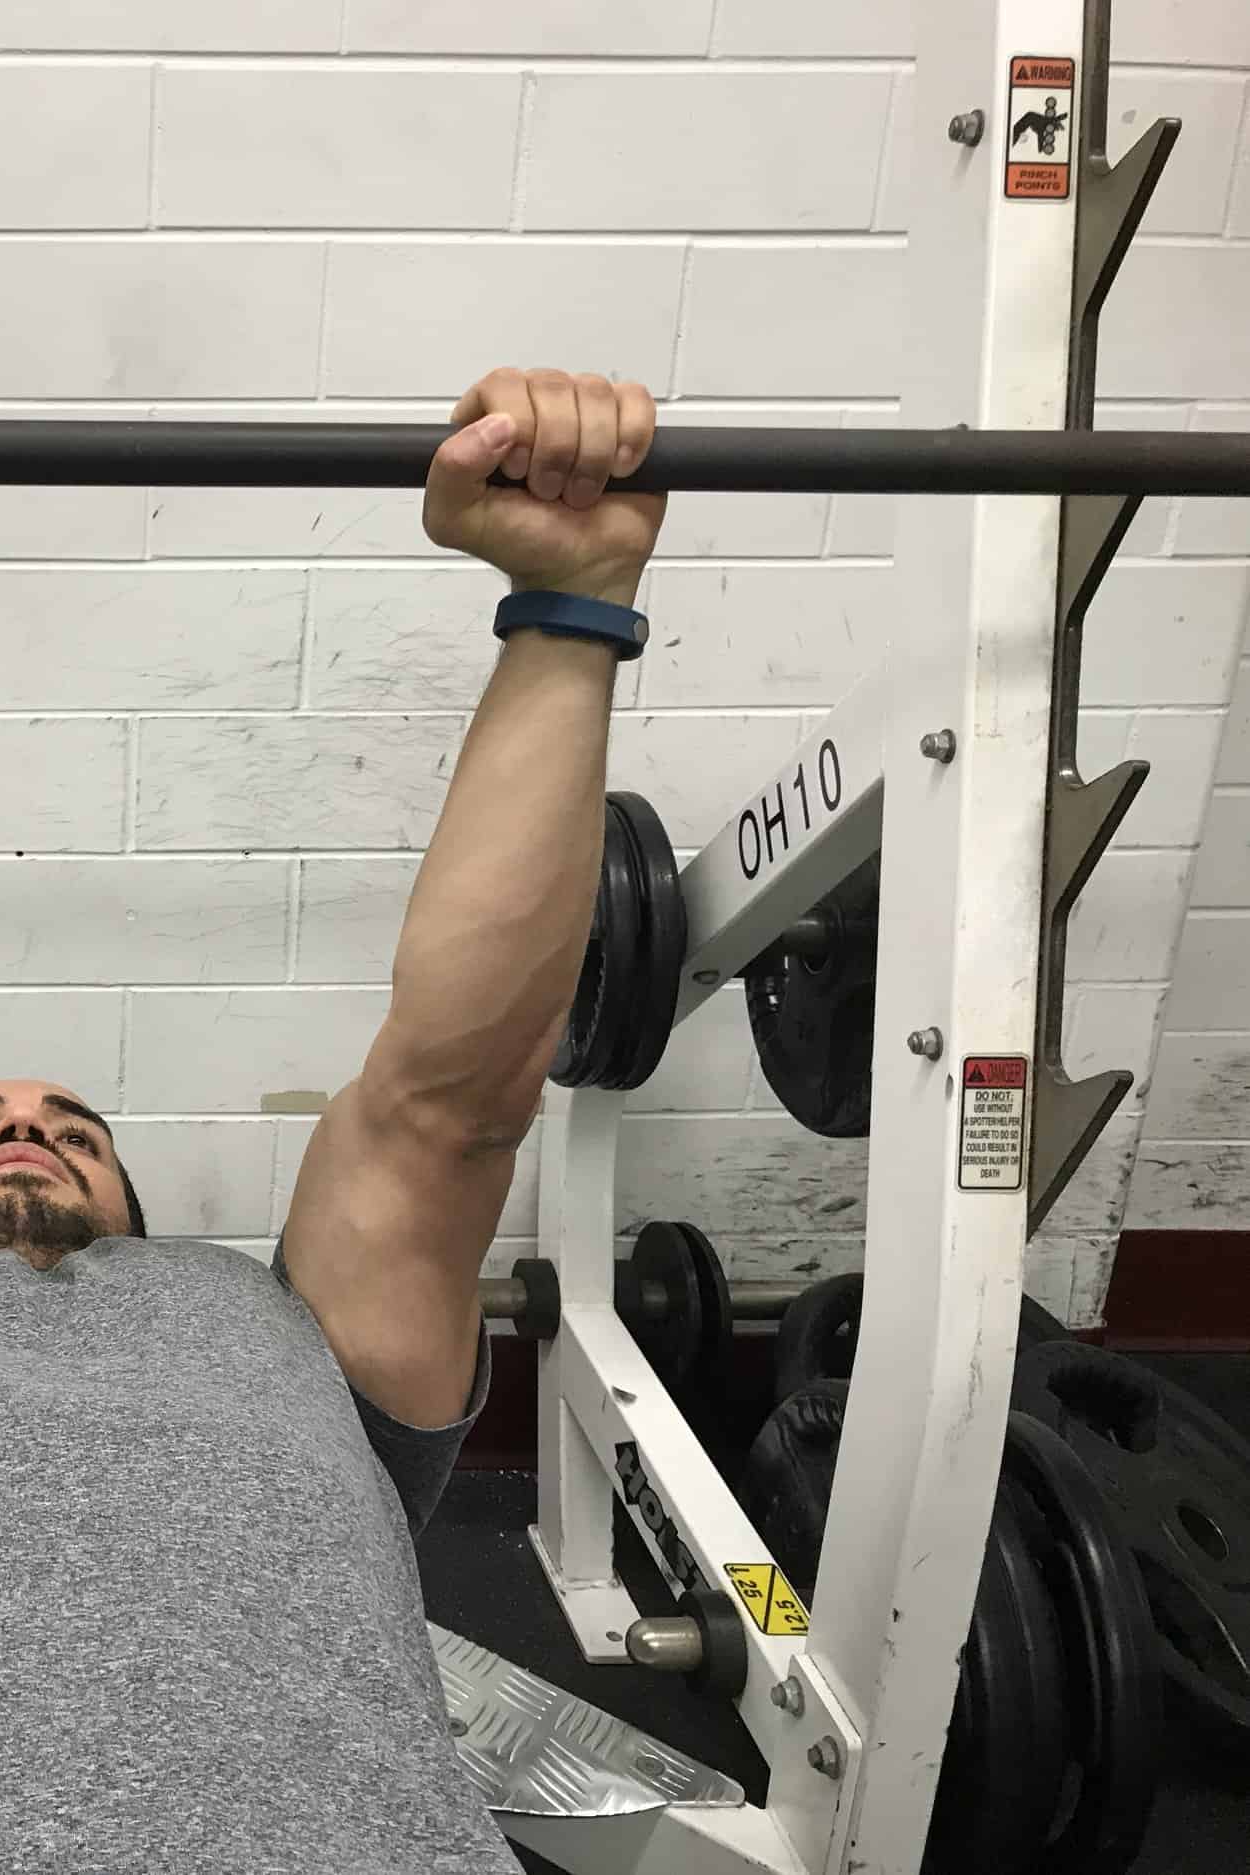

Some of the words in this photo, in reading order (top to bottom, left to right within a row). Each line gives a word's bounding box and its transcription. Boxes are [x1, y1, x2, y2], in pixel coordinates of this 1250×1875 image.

[1030, 65, 1071, 81] WARNING
[1019, 170, 1057, 179] PINCH
[1015, 180, 1061, 190] POINTS
[738, 738, 841, 880] OH10
[988, 1063, 1022, 1083] DANGER
[976, 1091, 989, 1101] DO
[987, 1103, 1013, 1113] WITHOUT
[991, 1130, 999, 1139] TO
[980, 1168, 1000, 1178] DEATH
